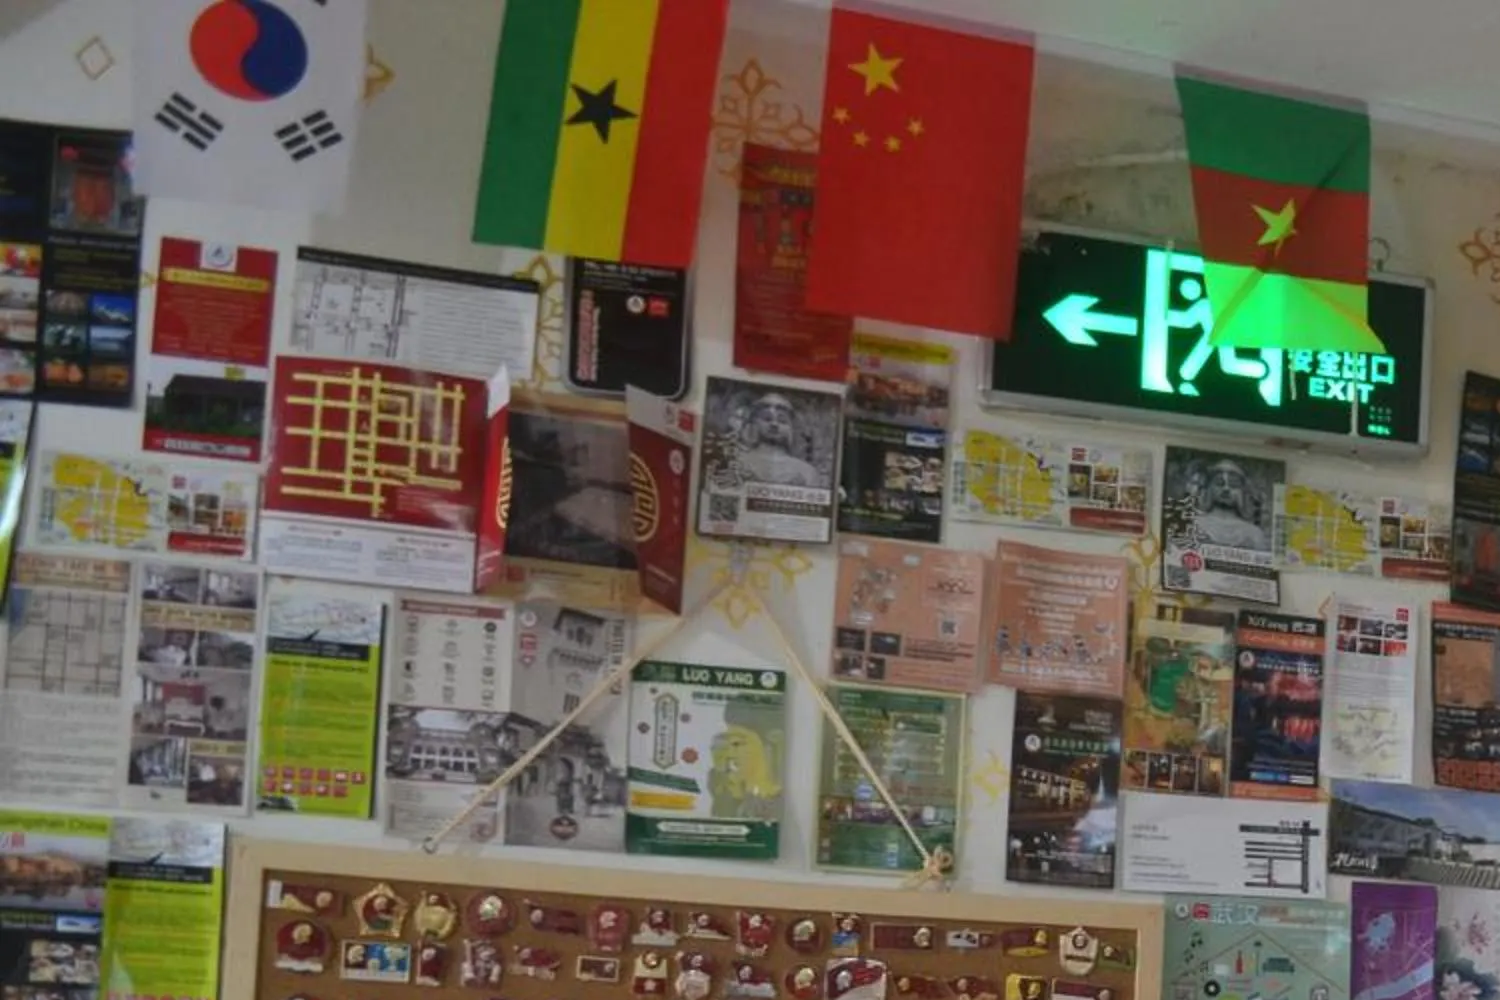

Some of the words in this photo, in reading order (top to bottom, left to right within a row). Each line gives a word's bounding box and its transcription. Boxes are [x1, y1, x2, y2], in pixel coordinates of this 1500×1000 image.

[1287, 350, 1396, 385] 安全出口
[1308, 377, 1375, 404] EXIT
[682, 667, 710, 682] LUO
[715, 670, 754, 686] YANG
